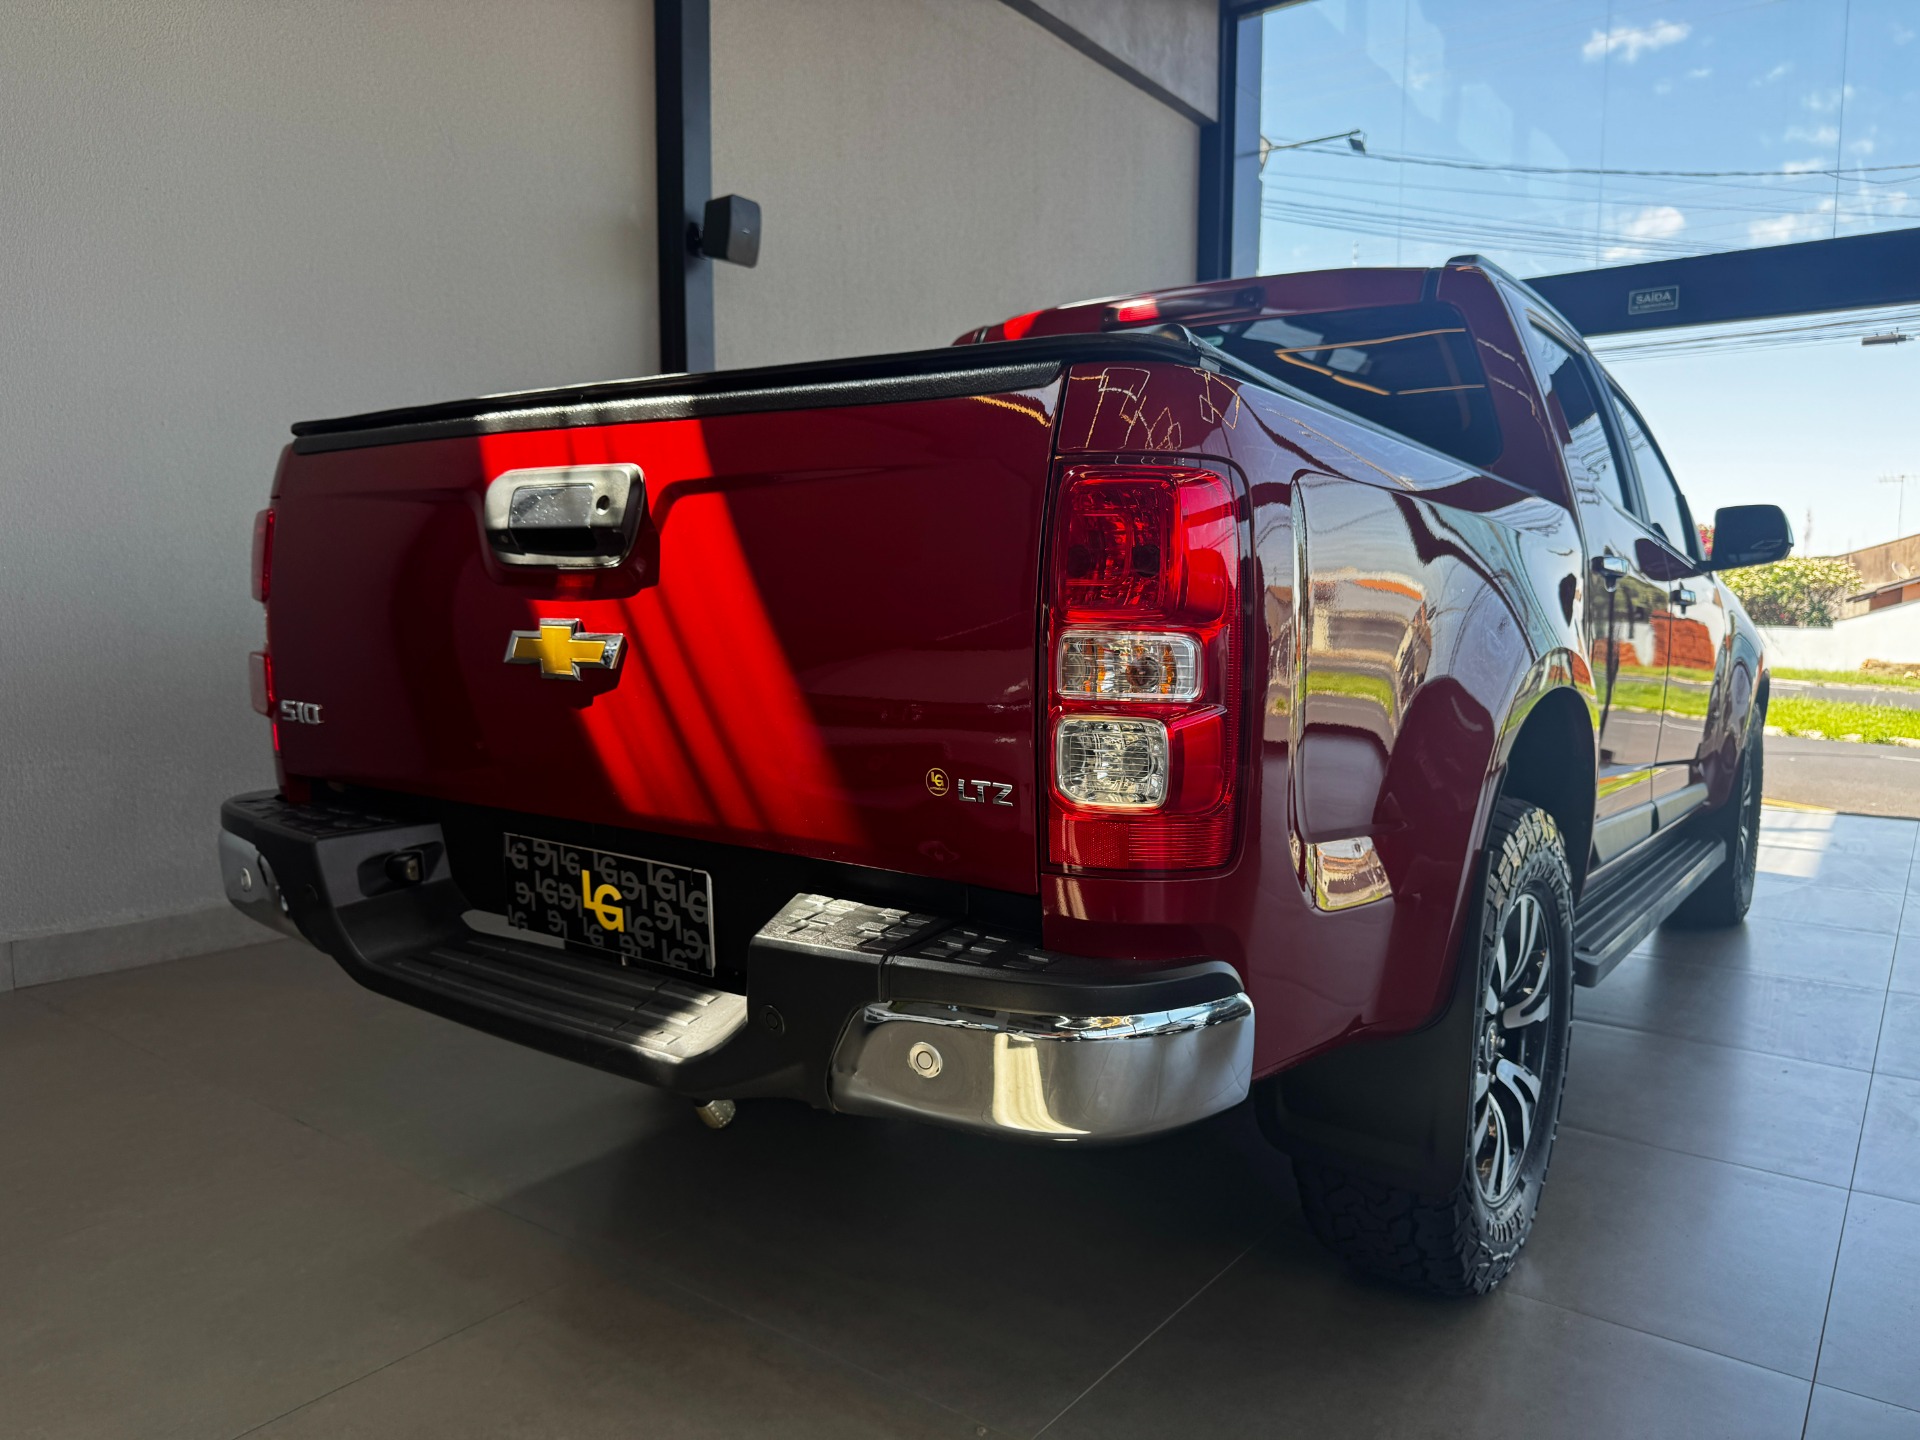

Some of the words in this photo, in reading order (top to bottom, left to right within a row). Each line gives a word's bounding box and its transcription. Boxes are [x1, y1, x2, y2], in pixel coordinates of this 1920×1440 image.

[281, 700, 320, 725] S10
[958, 779, 1013, 806] LTZ
[581, 869, 624, 933] LG
